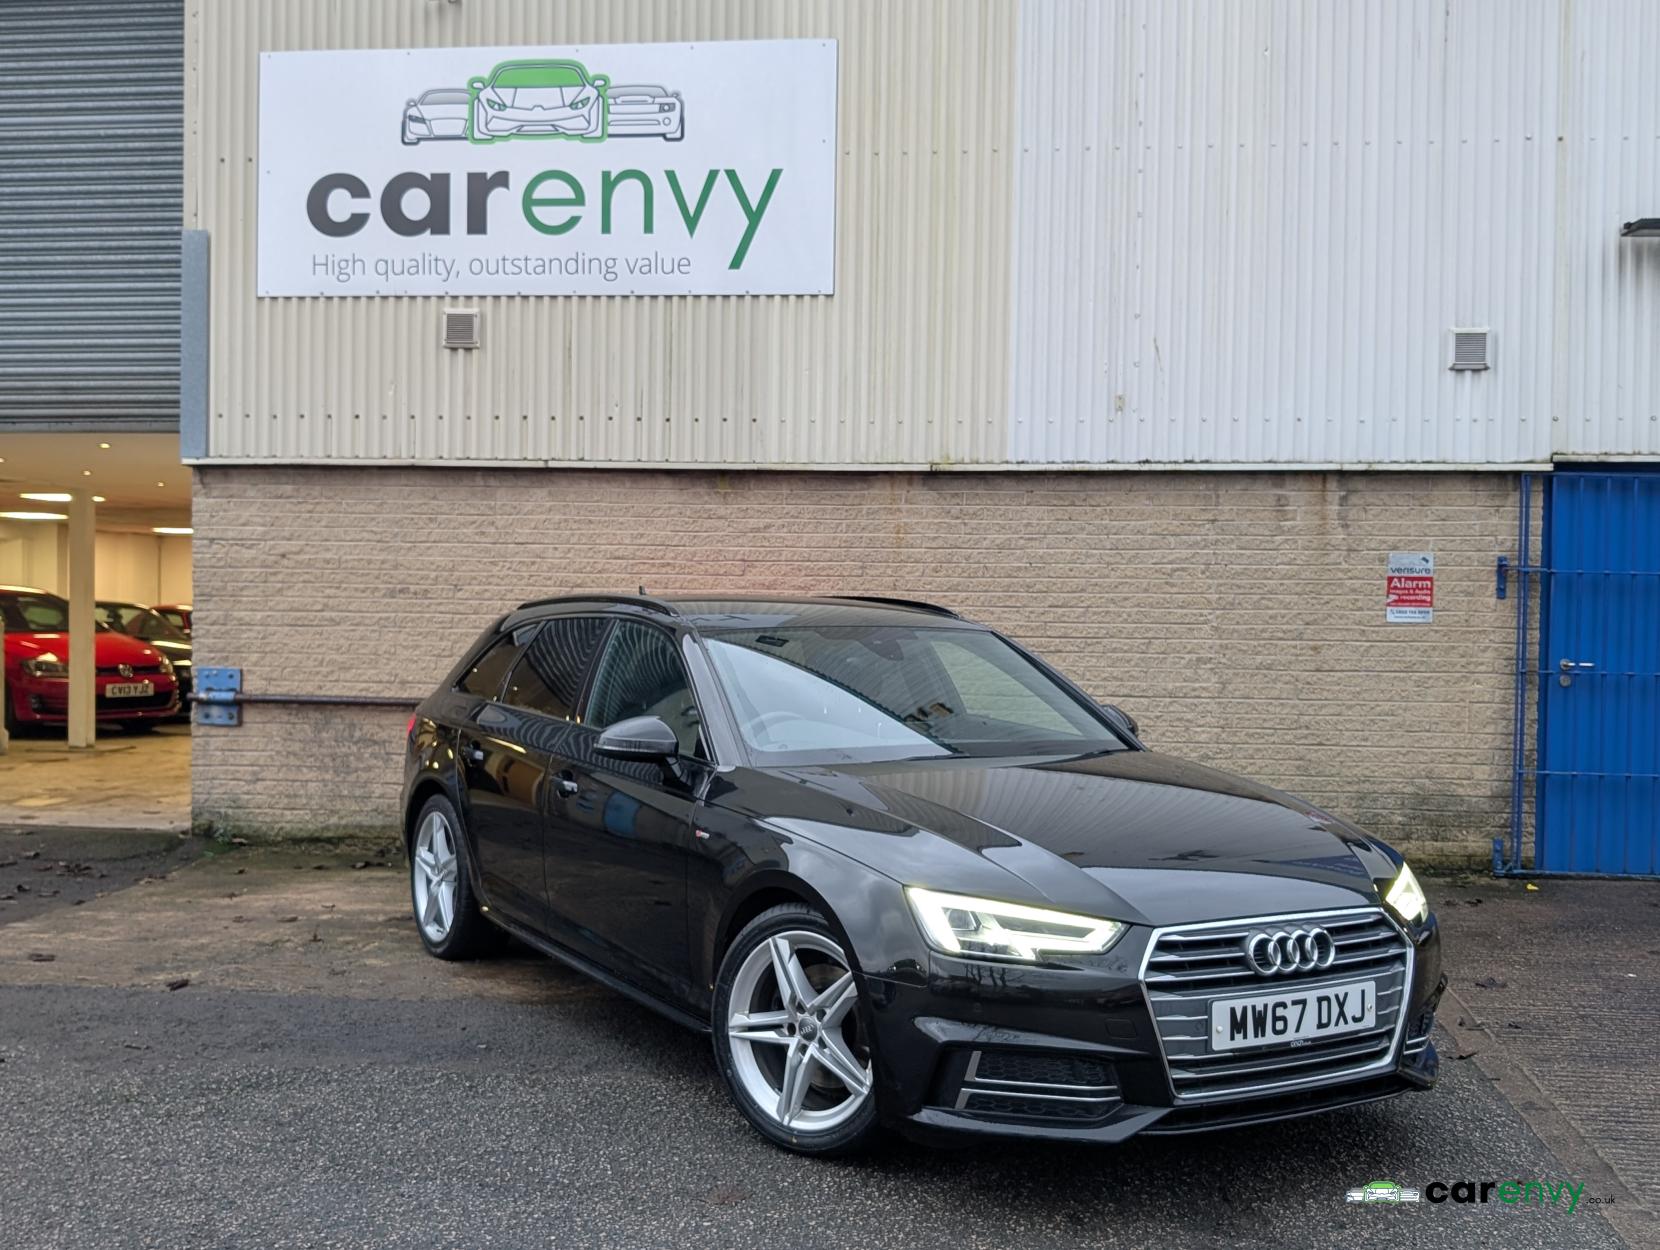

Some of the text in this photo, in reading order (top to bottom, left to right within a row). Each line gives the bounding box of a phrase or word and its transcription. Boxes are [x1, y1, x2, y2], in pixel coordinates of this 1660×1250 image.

[305, 168, 784, 270] carenvy
[311, 251, 692, 282] High quality, outstanding value
[1390, 577, 1431, 588] Alarm
[1400, 594, 1431, 602] recording
[1229, 989, 1366, 1042] MW67 DXJ
